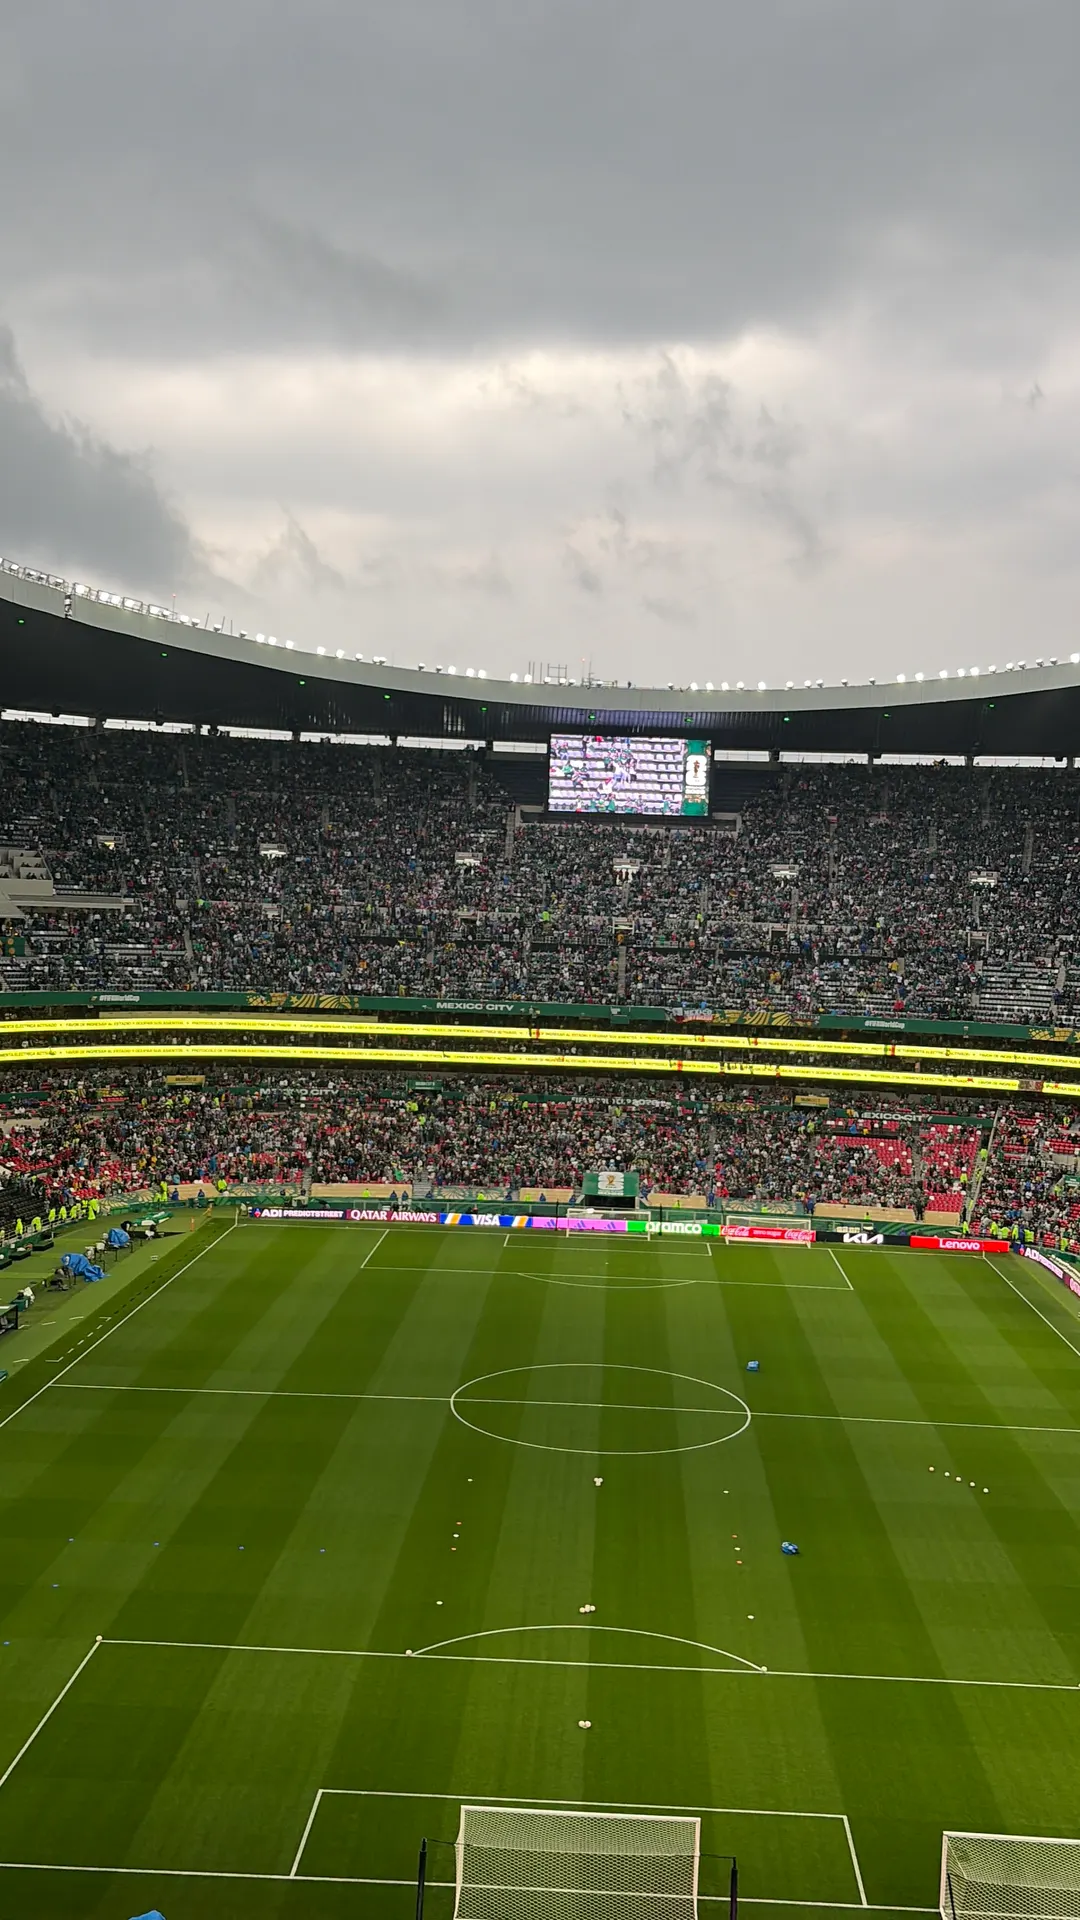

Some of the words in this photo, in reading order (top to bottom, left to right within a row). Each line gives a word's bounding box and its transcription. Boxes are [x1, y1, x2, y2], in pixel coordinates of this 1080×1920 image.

[261, 1209, 282, 1217] ADI
[350, 1210, 387, 1220] QATAR
[391, 1212, 436, 1222] AIRWAYS
[472, 1214, 500, 1225] VISA
[645, 1222, 702, 1234] aramco
[843, 1233, 884, 1244] KIA
[939, 1238, 980, 1250] Lenovo
